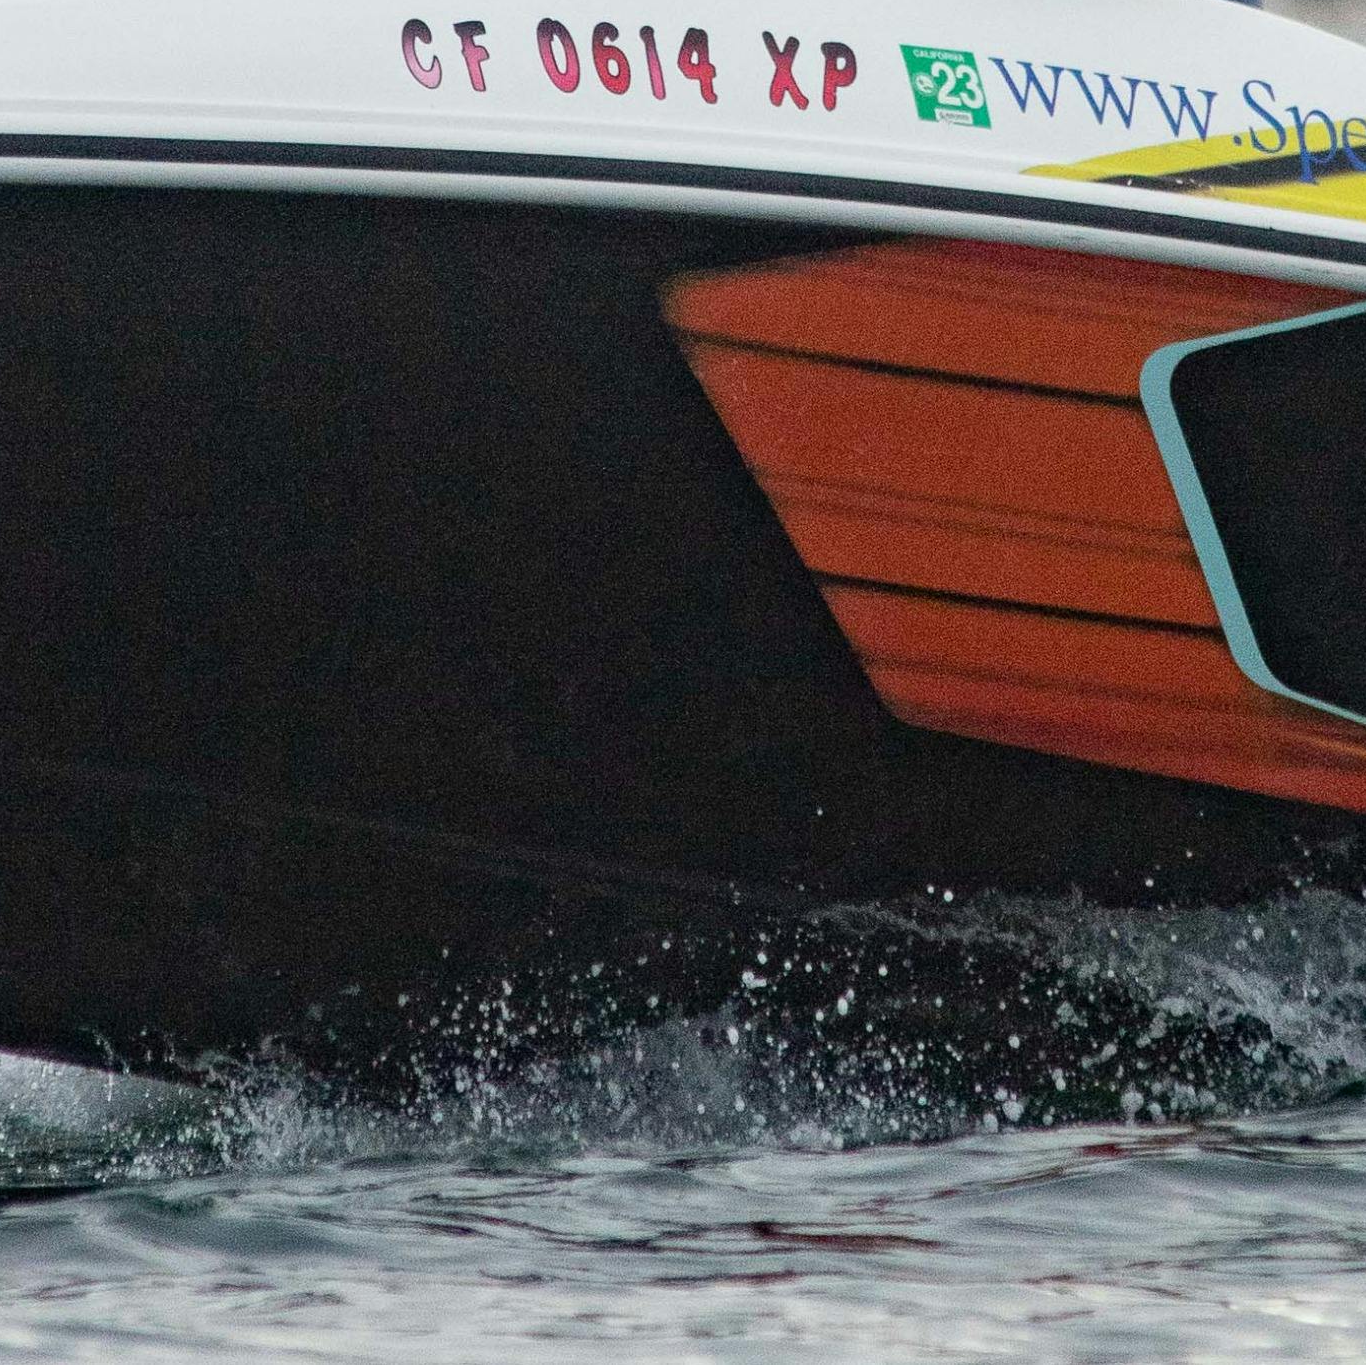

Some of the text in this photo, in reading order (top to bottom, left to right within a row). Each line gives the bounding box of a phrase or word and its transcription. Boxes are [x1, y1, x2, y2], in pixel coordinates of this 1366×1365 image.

[401, 17, 857, 111] CF 0614 XP
[912, 49, 965, 63] CALIFORNIA
[931, 61, 985, 109] 23
